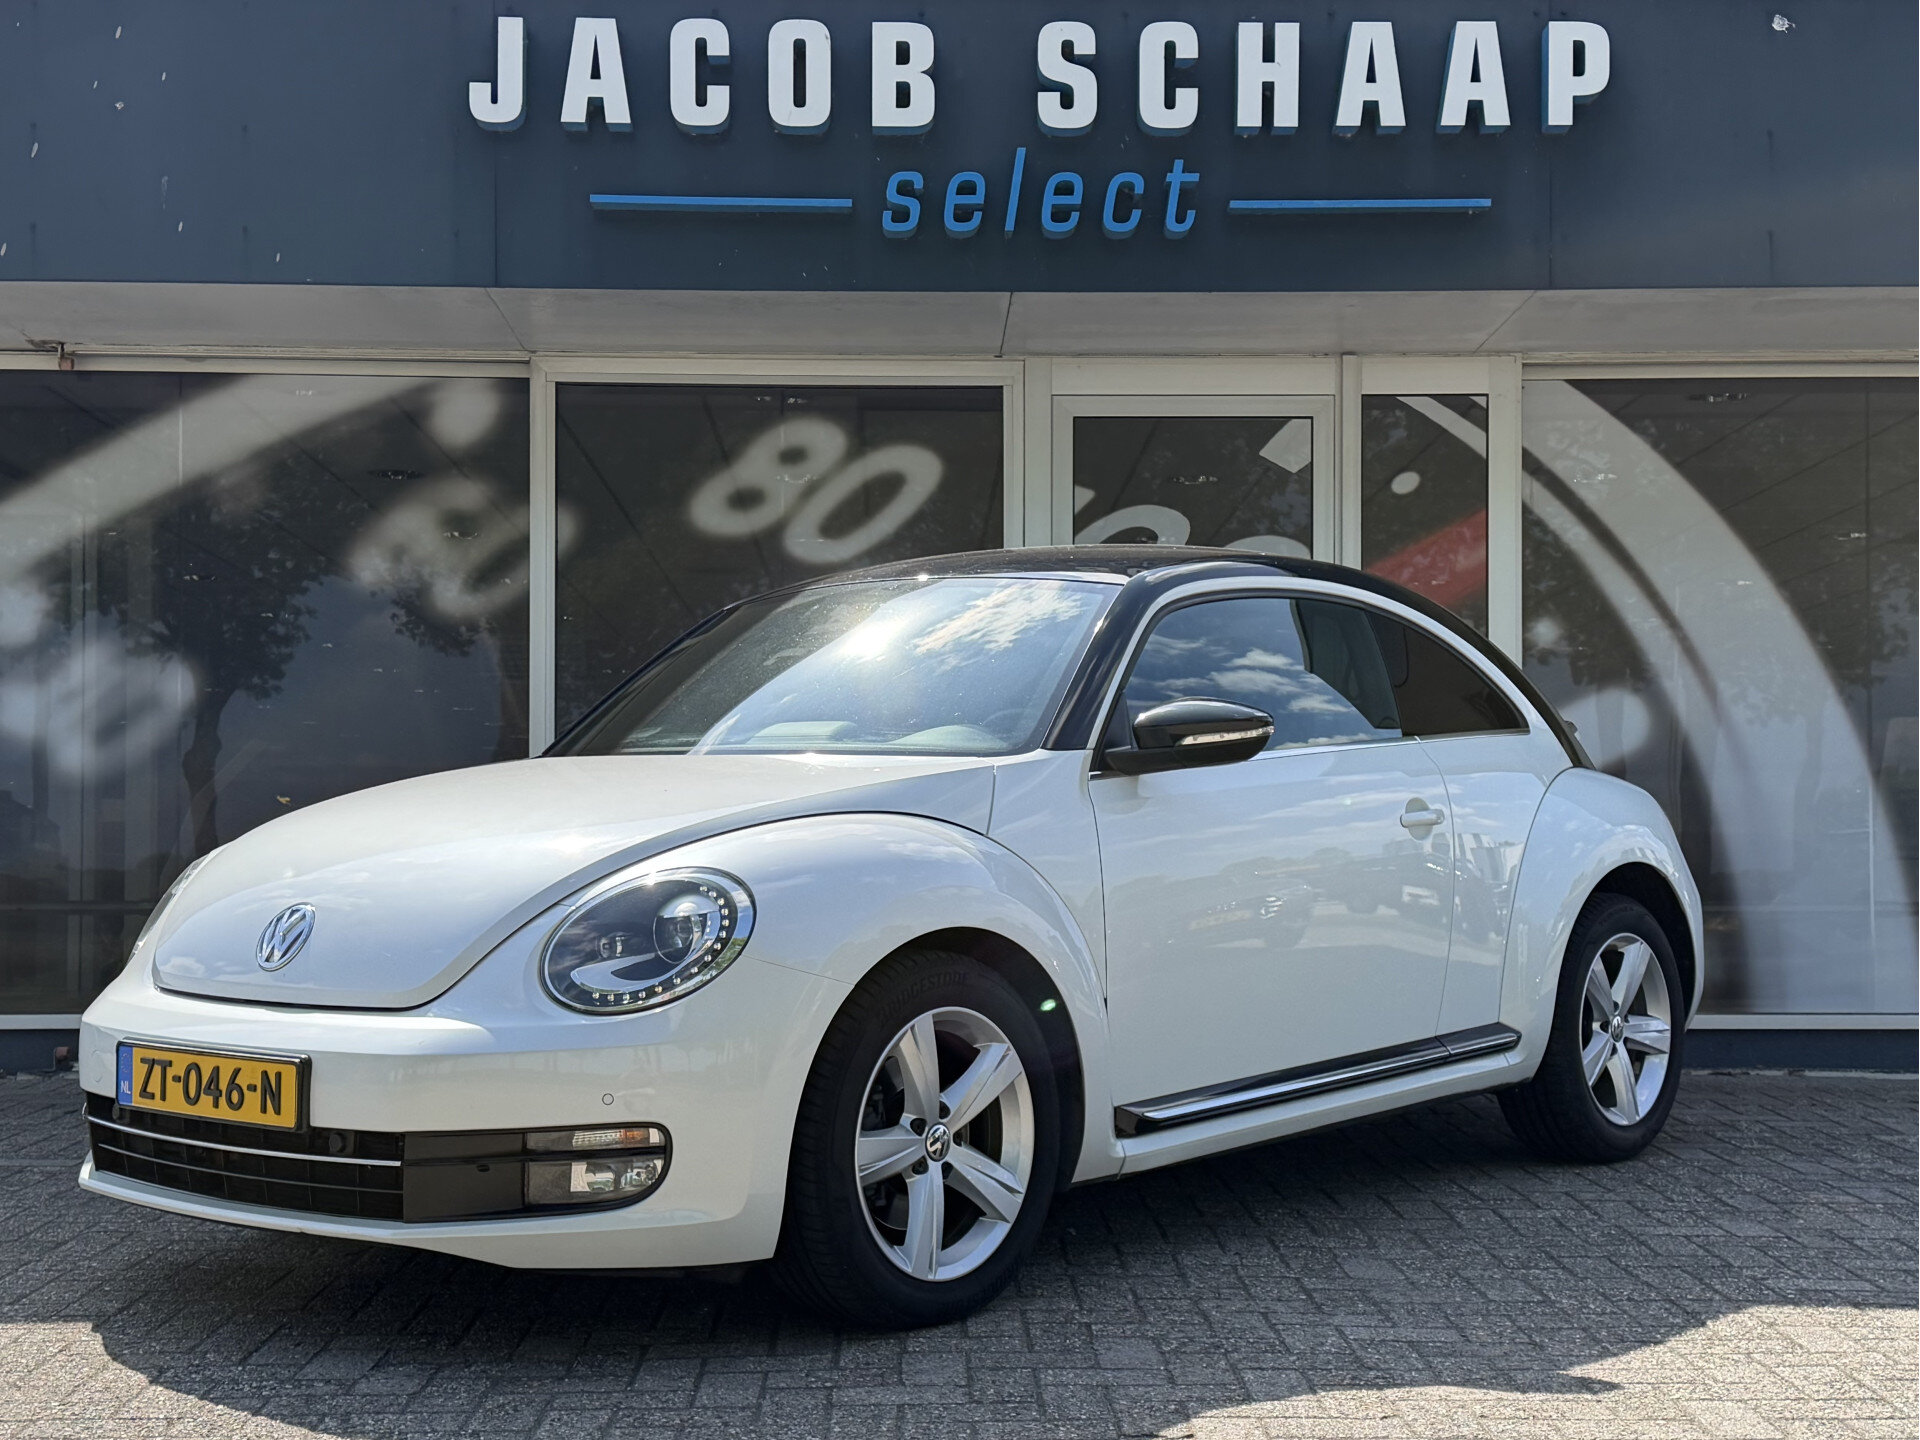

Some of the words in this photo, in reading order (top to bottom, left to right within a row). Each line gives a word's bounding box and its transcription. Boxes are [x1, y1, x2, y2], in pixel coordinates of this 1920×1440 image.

[469, 17, 935, 127] JACOB
[1037, 20, 1610, 129] SCHAAP
[882, 148, 1200, 233] select
[690, 415, 943, 564] 80
[120, 1080, 131, 1095] NL
[139, 1058, 282, 1115] ZT-046-N
